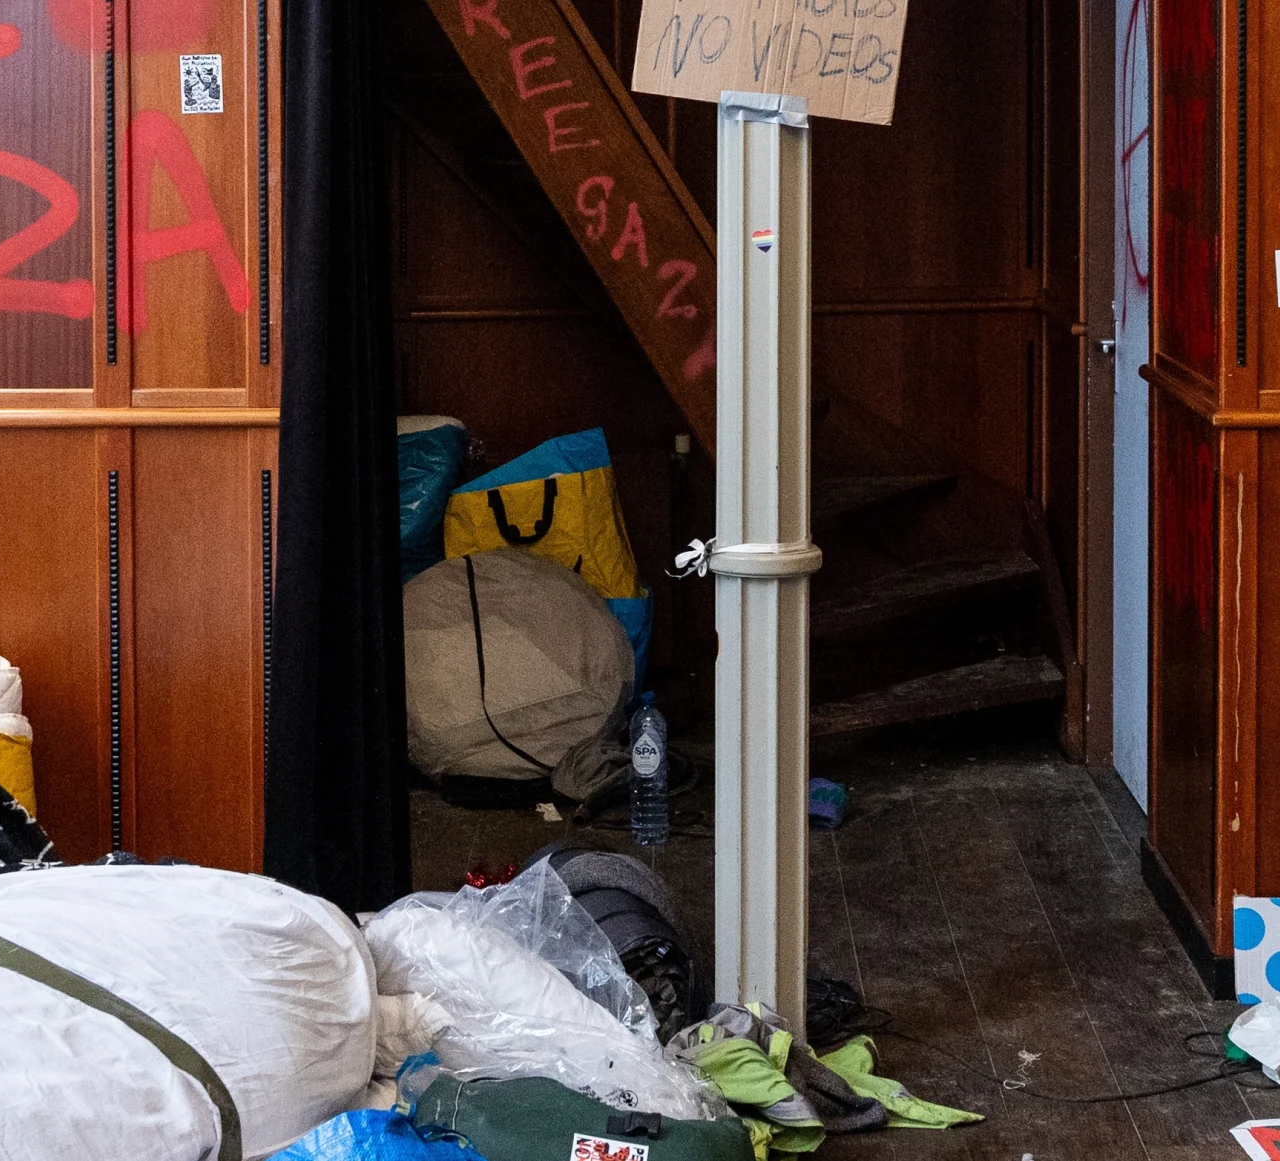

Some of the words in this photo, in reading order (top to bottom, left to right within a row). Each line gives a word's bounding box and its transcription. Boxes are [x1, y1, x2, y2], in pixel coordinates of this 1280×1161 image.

[653, 13, 732, 79] NO
[752, 19, 898, 85] VIDEOS
[634, 746, 657, 756] SPA
